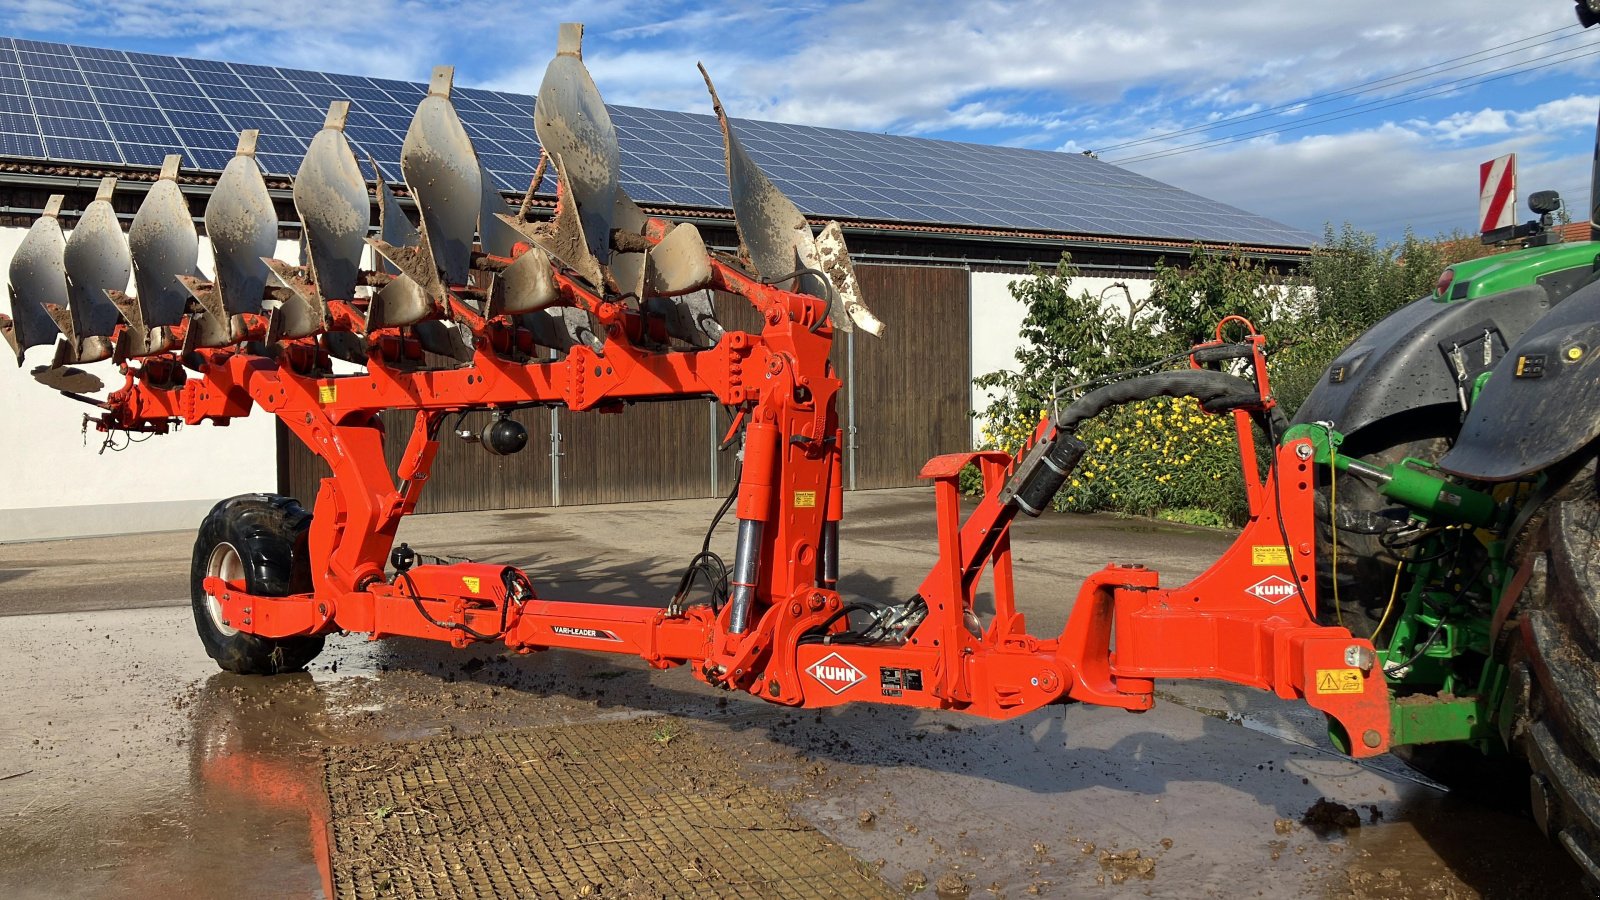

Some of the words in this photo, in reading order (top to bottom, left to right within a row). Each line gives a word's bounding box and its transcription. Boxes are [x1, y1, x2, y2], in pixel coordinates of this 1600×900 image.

[1255, 585, 1294, 596] KUHN
[554, 627, 596, 637] VARI-LEADER
[816, 665, 856, 682] KUHN
